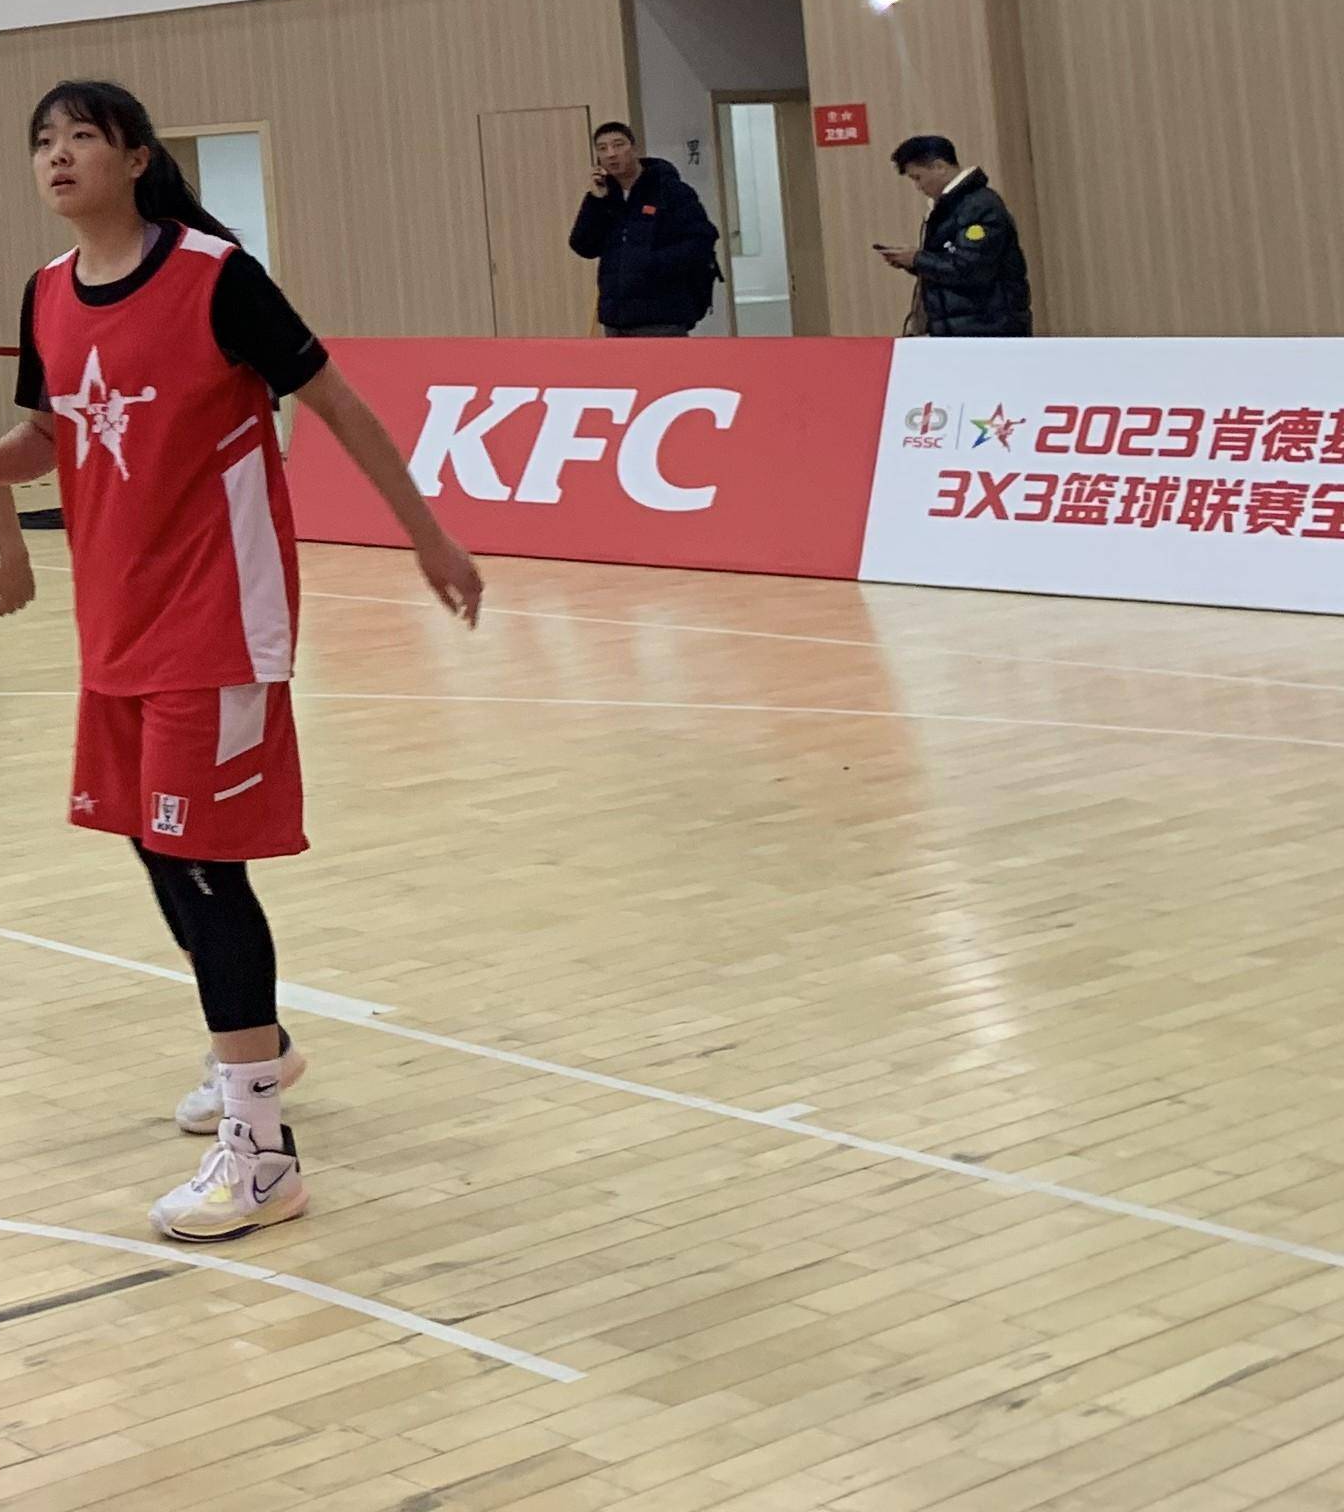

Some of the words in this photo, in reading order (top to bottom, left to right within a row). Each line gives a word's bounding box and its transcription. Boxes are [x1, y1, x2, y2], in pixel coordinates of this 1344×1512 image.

[824, 127, 858, 141] 卫生间
[687, 139, 700, 165] 男
[406, 383, 742, 513] KFC
[902, 436, 944, 449] FSSC
[156, 822, 180, 834] KFC
